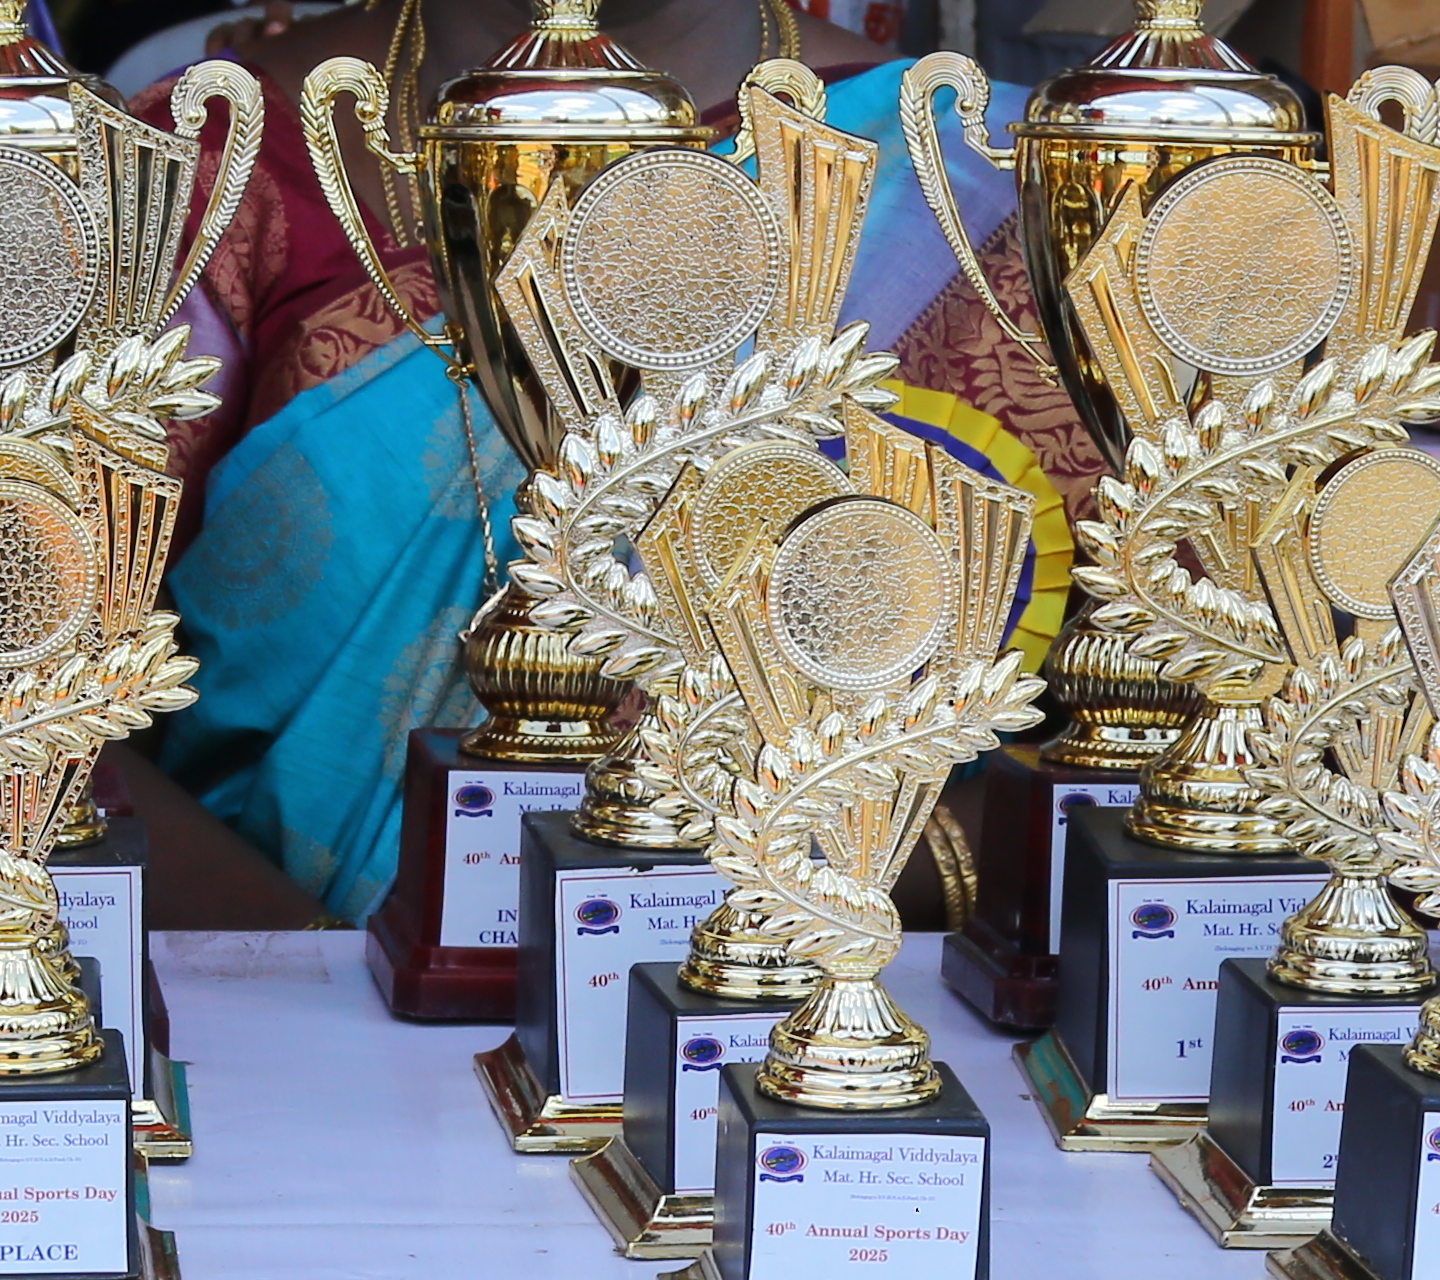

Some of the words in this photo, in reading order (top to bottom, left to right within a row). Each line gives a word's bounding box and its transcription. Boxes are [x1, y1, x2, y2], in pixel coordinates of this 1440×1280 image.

[504, 782, 580, 798] Kalaimagal
[463, 852, 490, 864] 40th
[59, 891, 116, 910] dyalaya
[630, 890, 717, 911] Kalaimagal
[1187, 898, 1272, 916] Kalaimagal
[648, 917, 678, 930] Mat.
[1204, 924, 1234, 936] Mat.
[1240, 923, 1262, 935] Hr.
[589, 972, 619, 987] 40th
[1142, 976, 1172, 990] 40th
[1183, 976, 1219, 992] Ann
[1329, 1027, 1400, 1041] Kalaimagal
[1177, 1038, 1202, 1058] 1st
[1288, 1099, 1315, 1111] 40th
[42, 1110, 121, 1126] Viddyalaya
[690, 1107, 718, 1121] 40th
[6, 1134, 28, 1147] Hr.
[32, 1134, 59, 1146] Sec.
[63, 1133, 108, 1146] School
[812, 1145, 893, 1163] Kalaimagal
[898, 1147, 978, 1166] Viddyalaya
[824, 1170, 854, 1183] Mat.
[859, 1171, 881, 1184] Hr.
[886, 1171, 913, 1184] Sec.
[918, 1172, 964, 1186] School
[24, 1187, 79, 1203] Sports
[84, 1187, 117, 1202] Day
[1, 1210, 38, 1223] 2025
[765, 1222, 796, 1235] 40th
[805, 1223, 868, 1238] Annual
[874, 1225, 930, 1242] Sports
[935, 1227, 970, 1244] Day
[0, 1245, 78, 1261] PLACE
[849, 1249, 887, 1262] 2025
